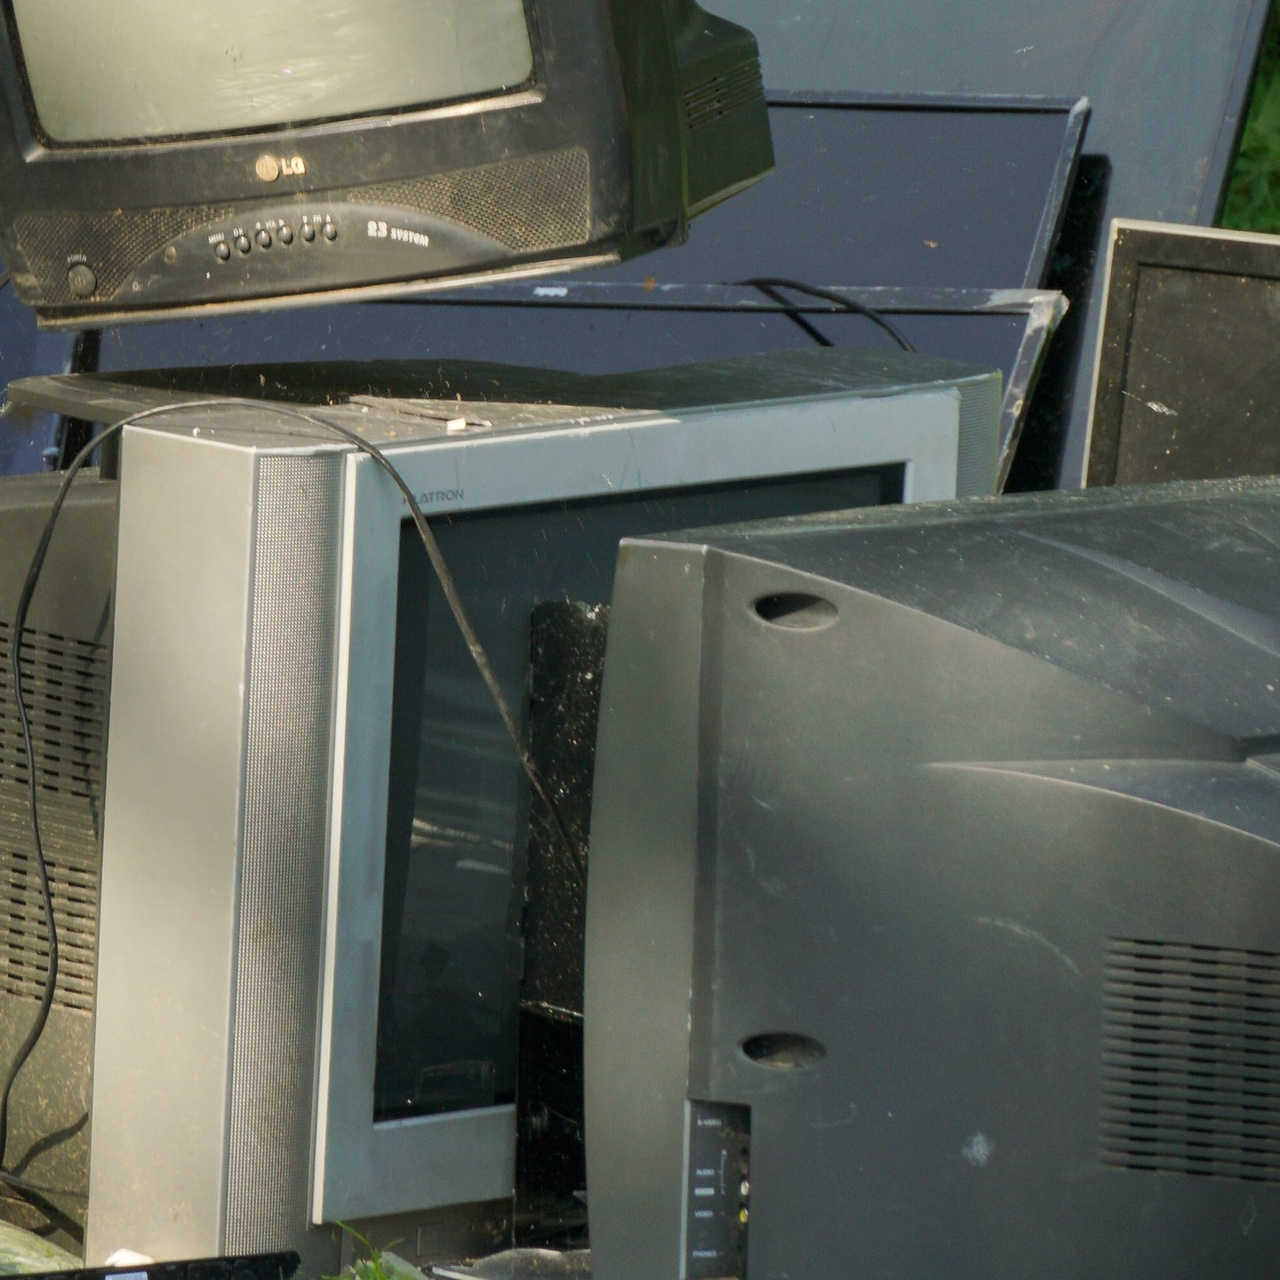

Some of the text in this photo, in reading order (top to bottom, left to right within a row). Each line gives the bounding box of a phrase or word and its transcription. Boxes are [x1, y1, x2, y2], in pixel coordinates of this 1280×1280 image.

[281, 156, 306, 176] LG
[233, 226, 244, 238] OK
[390, 227, 429, 247] SYSTEM
[403, 488, 464, 506] LATRON
